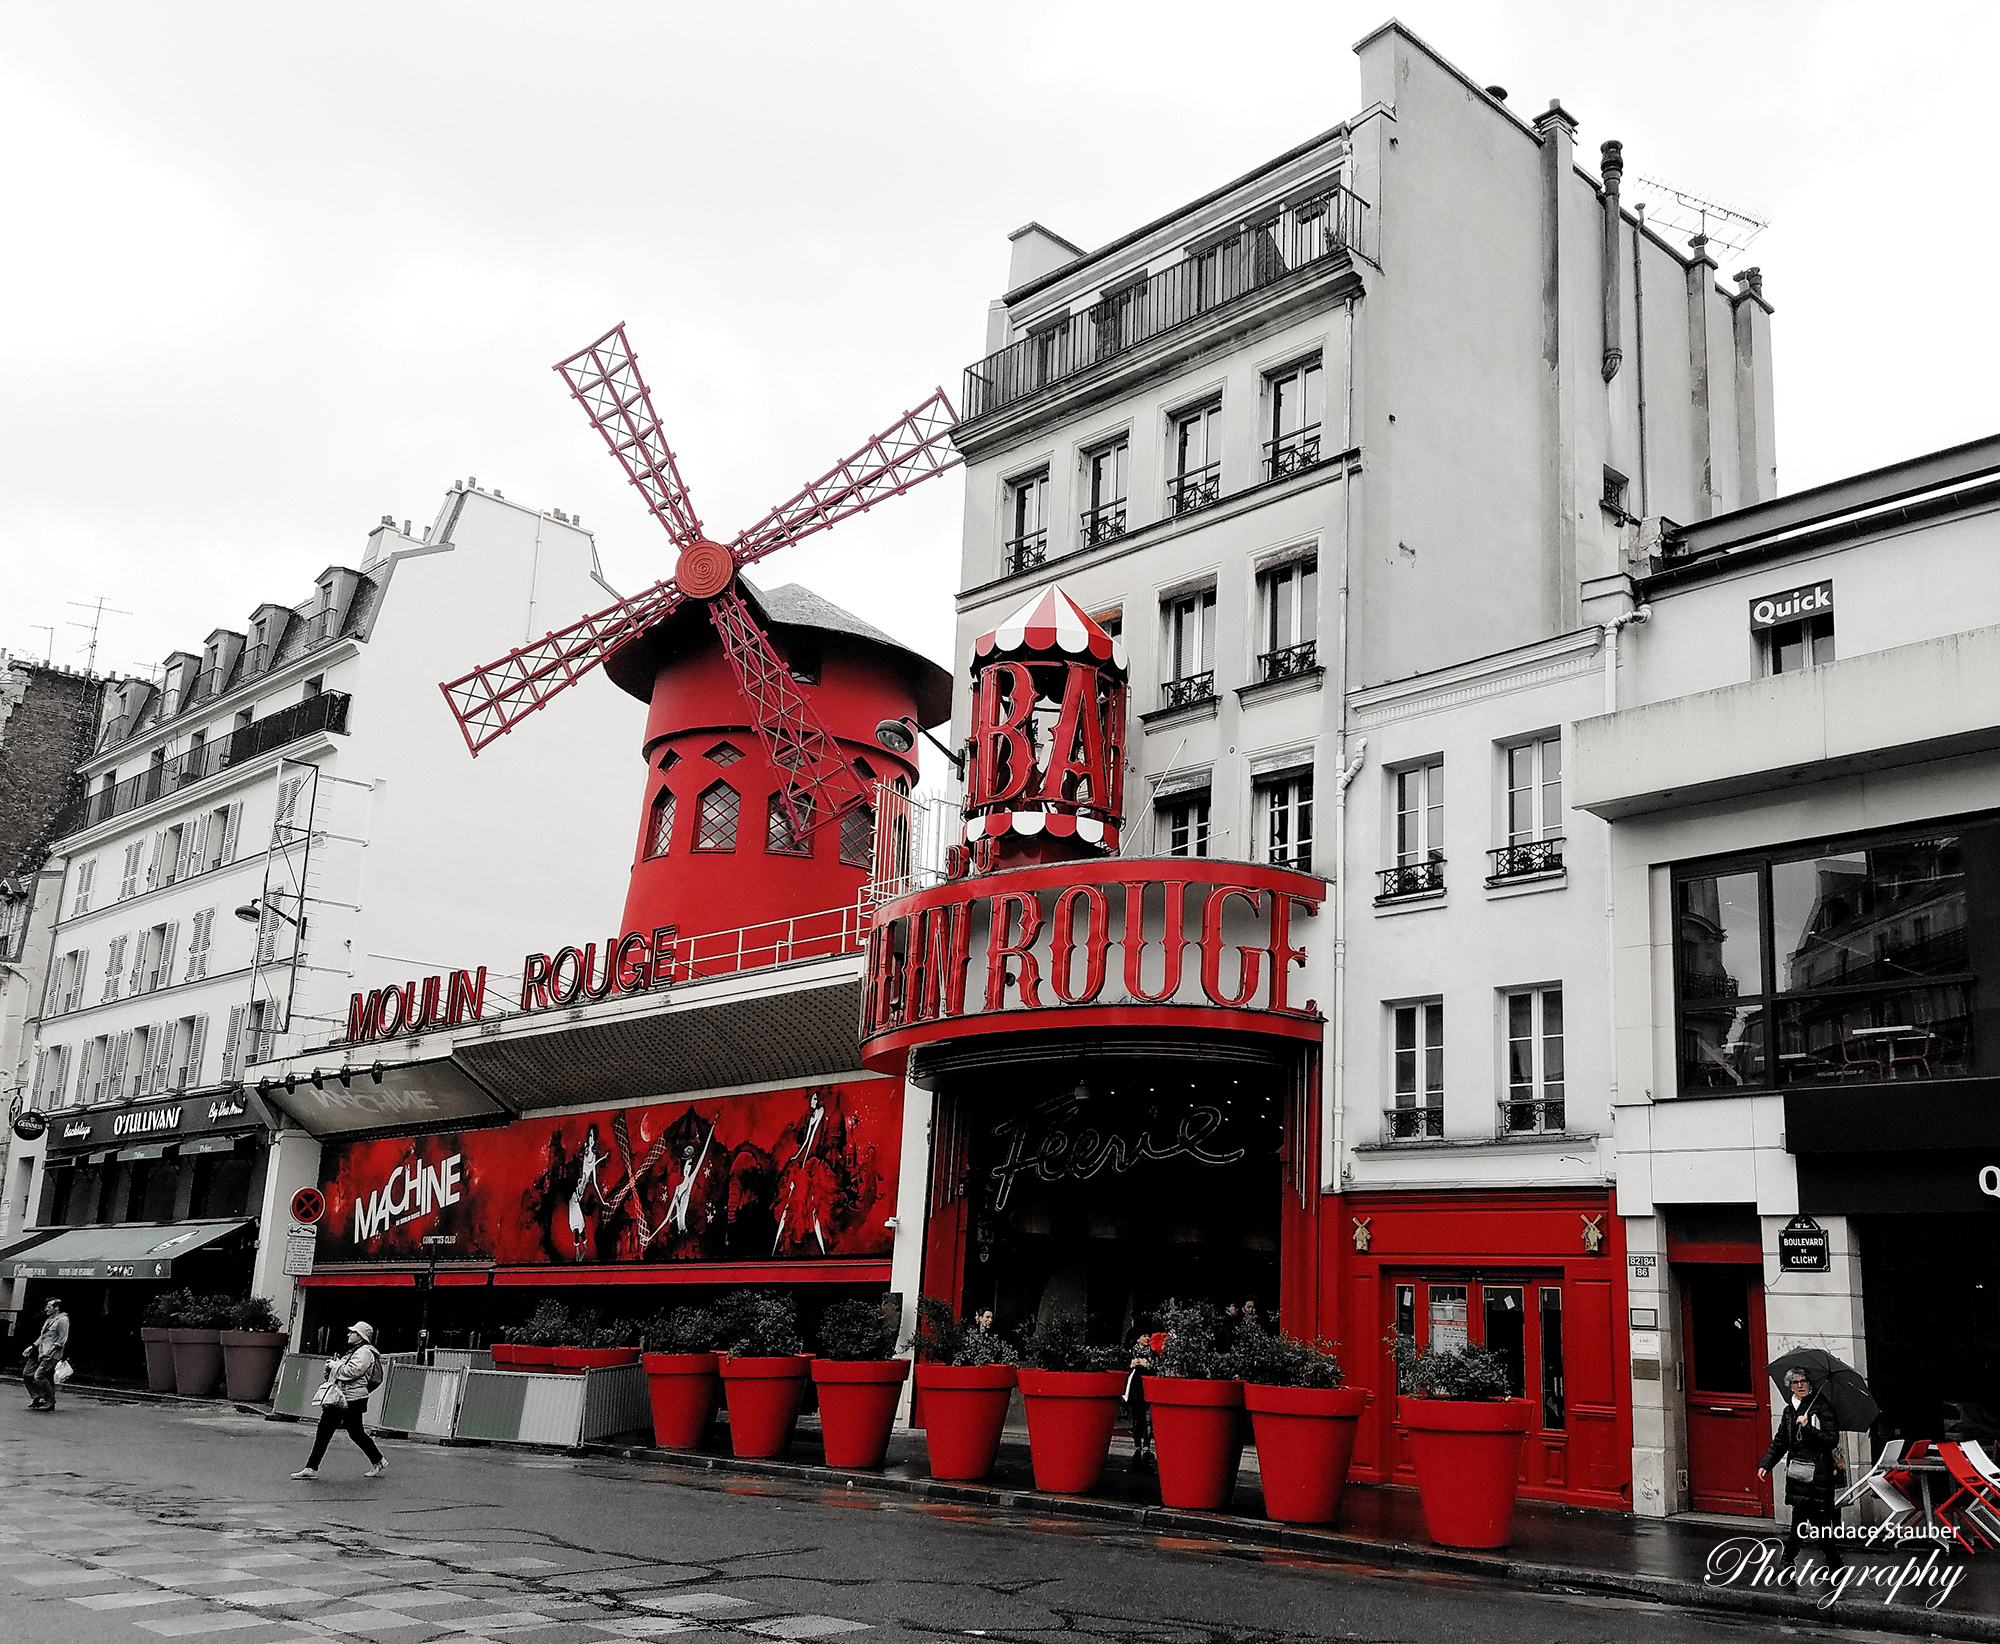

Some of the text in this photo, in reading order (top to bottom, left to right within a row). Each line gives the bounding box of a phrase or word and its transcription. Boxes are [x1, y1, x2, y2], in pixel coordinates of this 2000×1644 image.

[1753, 586, 1831, 625] Quick
[985, 880, 1319, 1020] ROUGE
[345, 924, 680, 1043] MOULIN ROUGE
[113, 1106, 182, 1136] O'SULLIVANS
[354, 1153, 461, 1244] MACHINE
[1783, 1238, 1824, 1246] BOULEVARD
[1629, 1256, 1641, 1266] 82
[1636, 1267, 1648, 1277] 86
[1790, 1256, 1818, 1264] CLICHY
